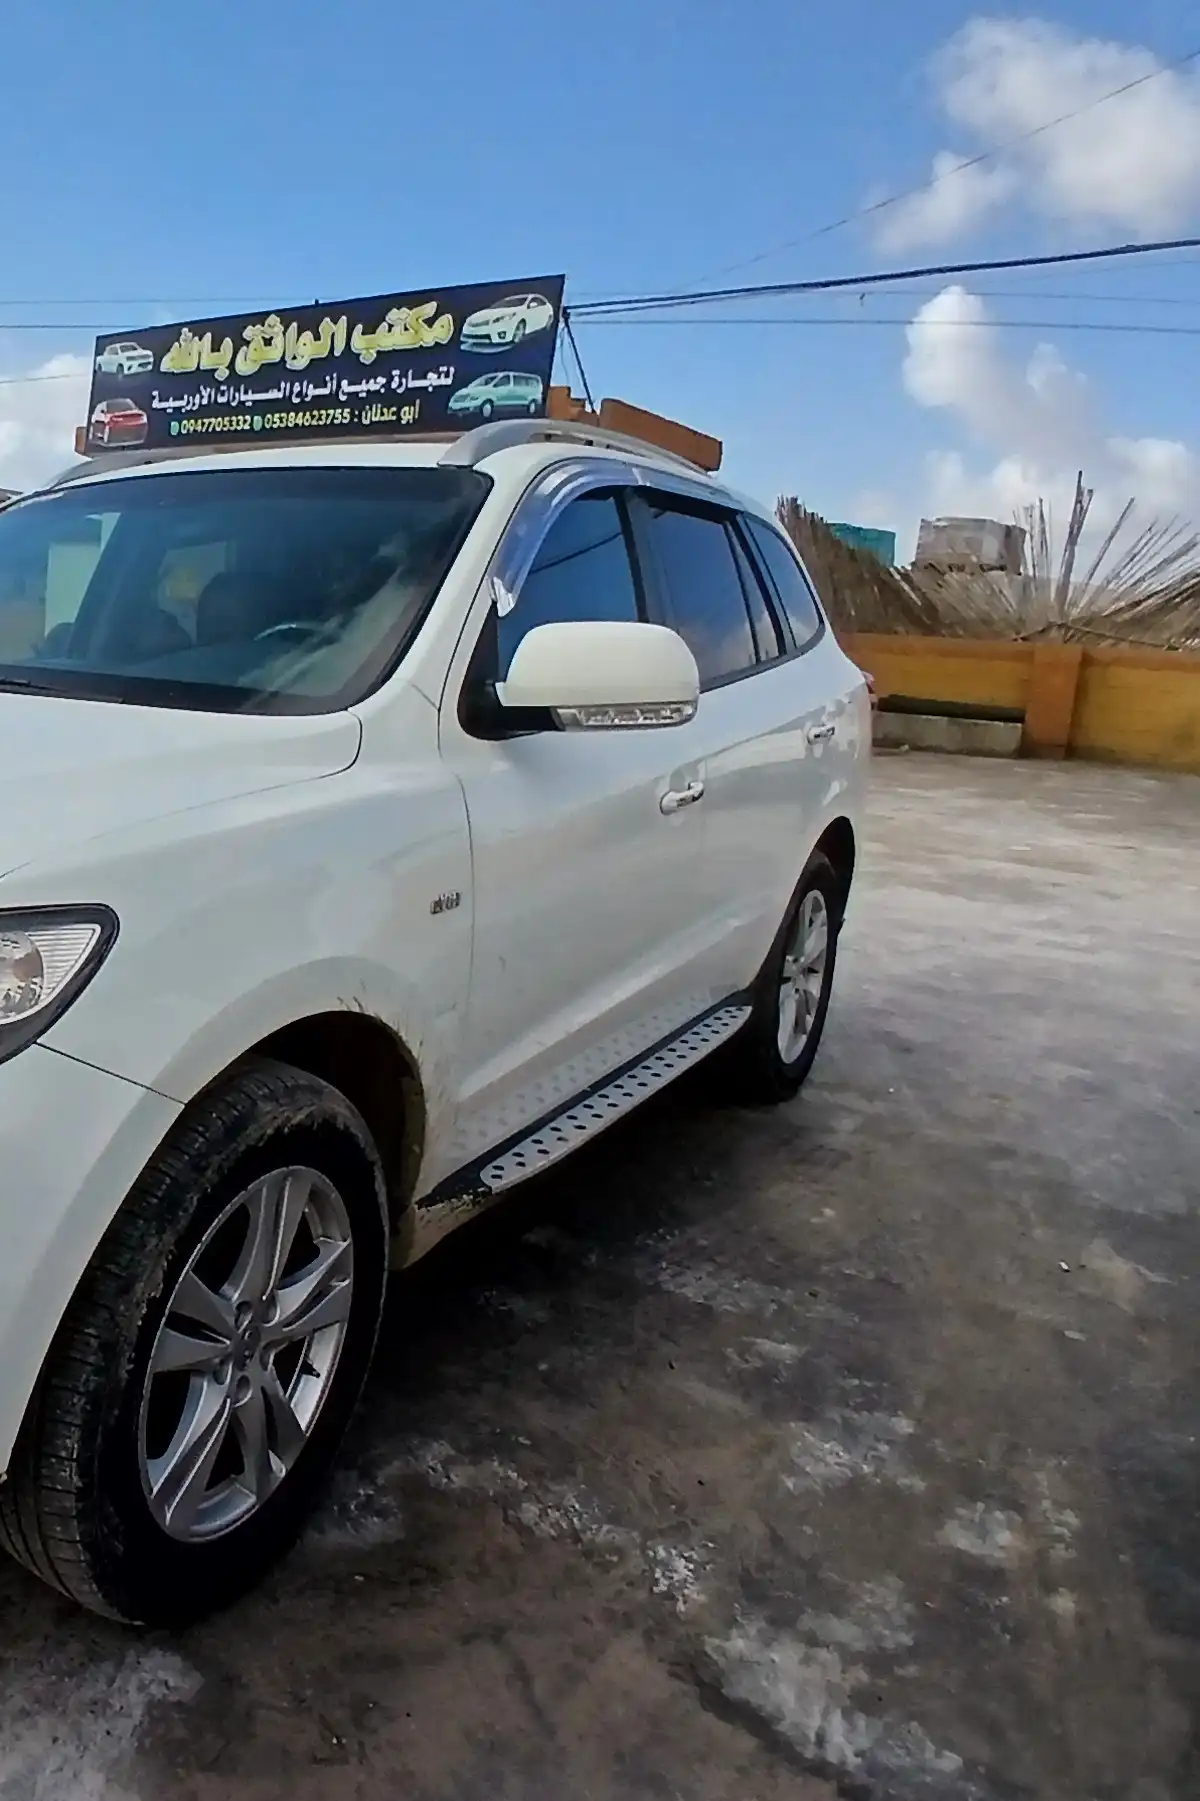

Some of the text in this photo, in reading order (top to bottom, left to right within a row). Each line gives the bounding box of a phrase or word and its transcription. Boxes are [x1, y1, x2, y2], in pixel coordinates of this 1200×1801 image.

[160, 301, 454, 381] مكتب الواثق بالله
[339, 376, 386, 401] جميع
[391, 365, 455, 393] لتجارة
[217, 381, 290, 407] السيارات
[181, 415, 251, 434] 0947705332
[264, 408, 351, 429] 05384623755
[361, 403, 397, 425] عدنان
